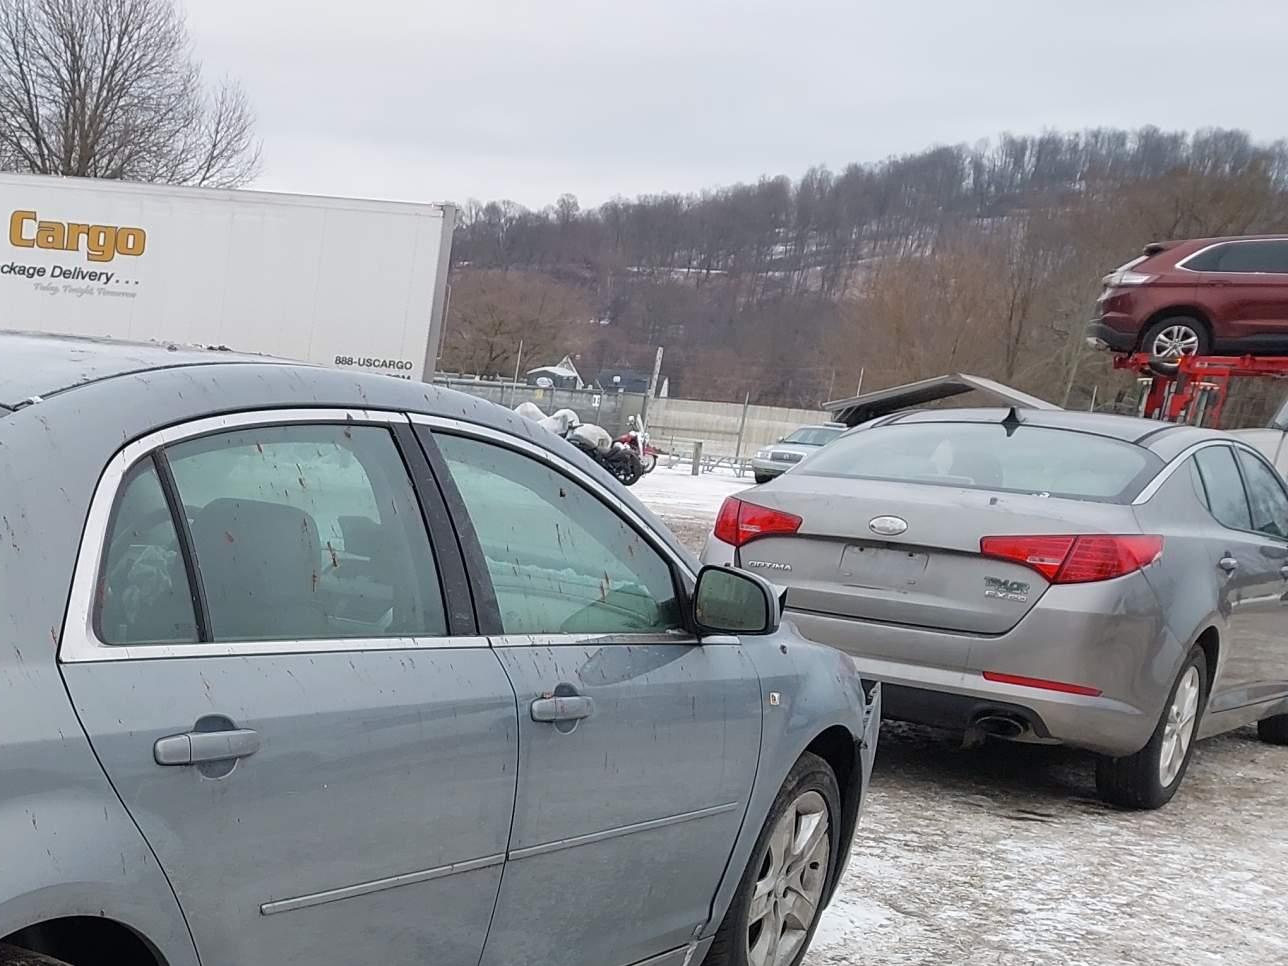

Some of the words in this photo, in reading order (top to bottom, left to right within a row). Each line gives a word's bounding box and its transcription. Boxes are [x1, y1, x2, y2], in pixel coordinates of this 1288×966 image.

[9, 210, 146, 263] Cargo
[334, 355, 413, 370] 888-USCARGO
[748, 560, 792, 570] OPTIMA
